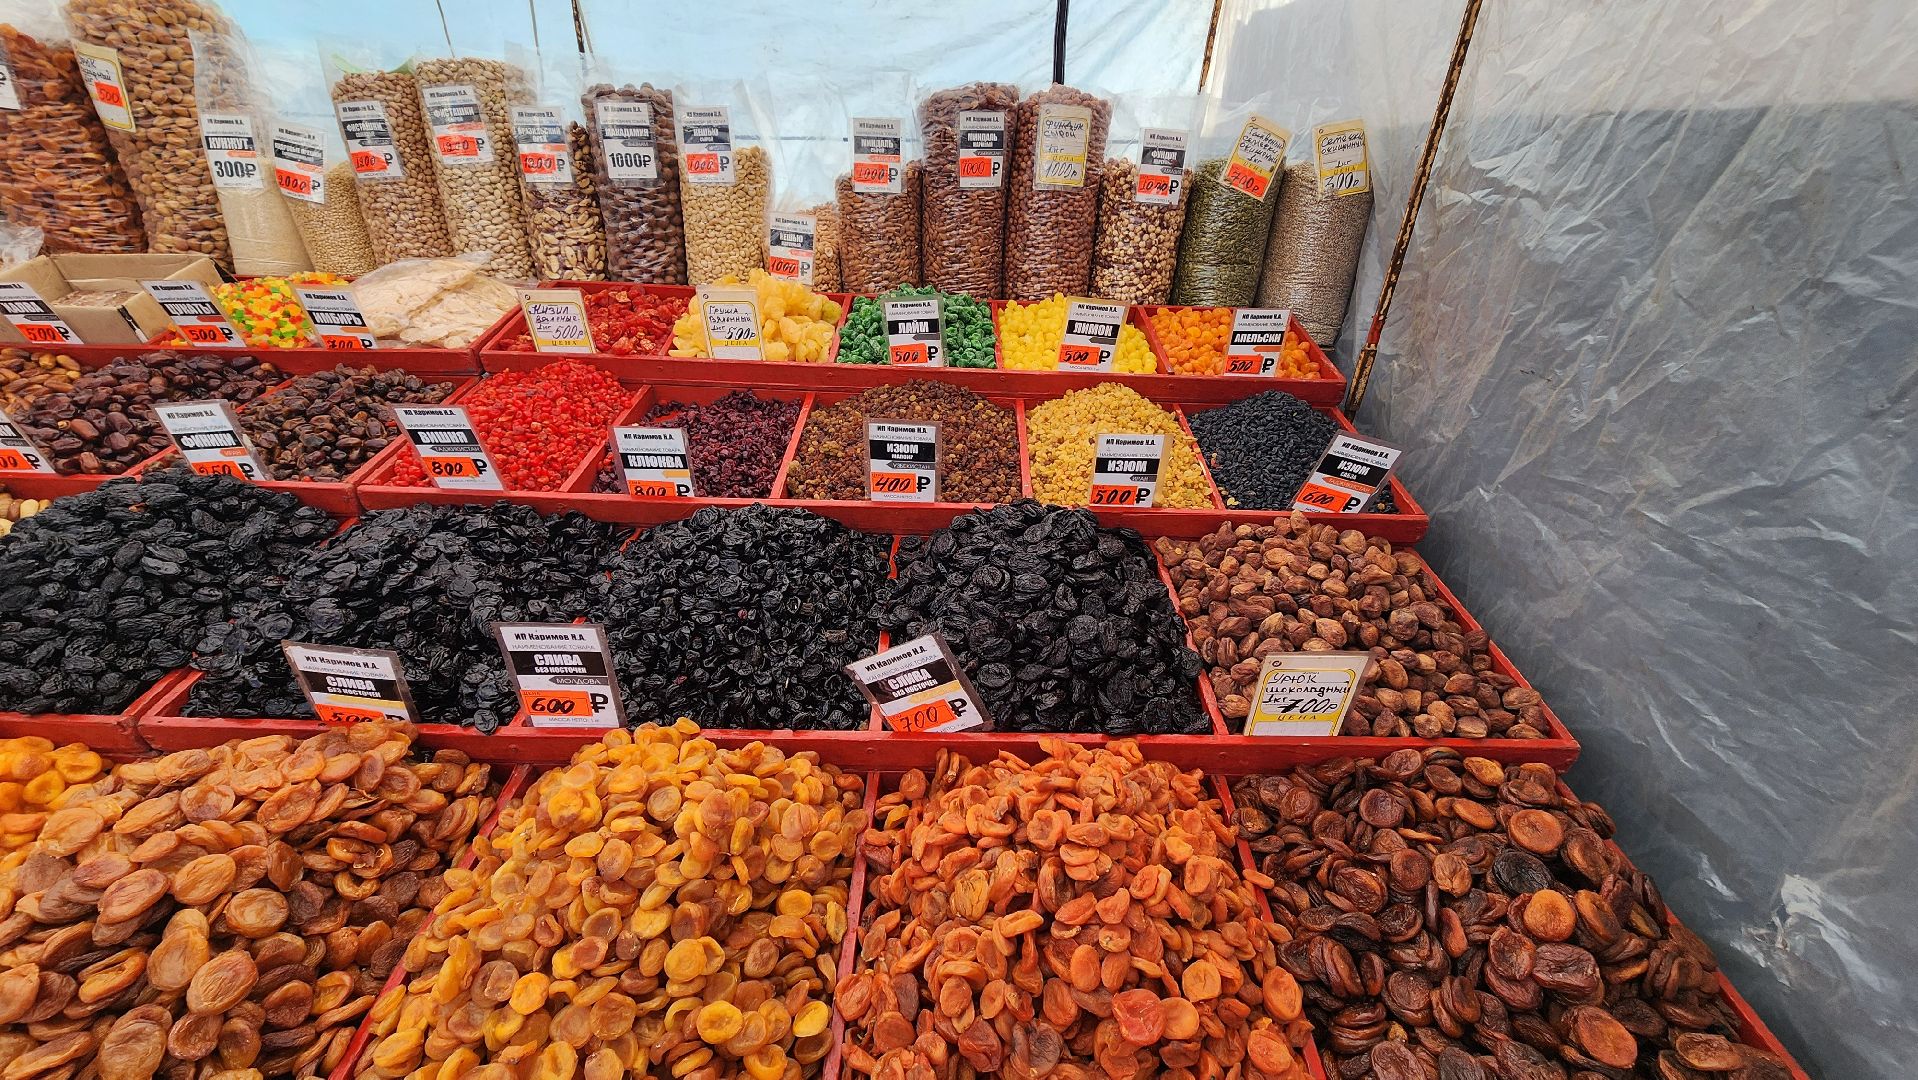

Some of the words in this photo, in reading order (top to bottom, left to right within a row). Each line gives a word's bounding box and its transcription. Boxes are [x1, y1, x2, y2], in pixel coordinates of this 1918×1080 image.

[432, 106, 475, 118] ФИСТАШКИ
[346, 121, 384, 132] ФИСТАШКИ
[605, 127, 649, 138] МАКАДАМИЯ
[693, 127, 719, 137] КЕШЬЮ
[208, 136, 249, 150] КУНЖУТ
[860, 139, 894, 149] МИНДАЛЬ
[966, 131, 999, 143] МИНДАЛЬ
[1151, 150, 1178, 161] ФУНДУК
[961, 160, 985, 174] 1000
[770, 256, 796, 273] 1000
[163, 302, 216, 316] ЦУКАТЫ
[311, 311, 364, 326] ИМБИРЬ
[27, 326, 56, 341] 500
[897, 319, 930, 334] ЛАЙМ
[1072, 321, 1115, 338] ЛИМОН
[189, 330, 217, 341] 500
[894, 351, 919, 363] 500
[1064, 349, 1089, 363] 500
[1228, 360, 1254, 373] 500
[412, 409, 444, 417] Каримов
[180, 433, 237, 448] ФИНИКИ
[416, 431, 469, 444] ВИШНЯ
[632, 433, 663, 441] Каримов
[1115, 438, 1144, 446] Каримов
[886, 442, 919, 455] ИЗЮМ
[1350, 442, 1379, 457] Каримов
[431, 461, 463, 476] 800
[627, 454, 685, 469] КЛЮКВА
[1106, 459, 1148, 473] ИЗЮМ
[1336, 459, 1371, 476] ИЗЮМ
[634, 486, 667, 497] 800
[875, 477, 912, 492] 400
[1093, 488, 1130, 505] 500
[1302, 491, 1335, 505] 600
[528, 633, 570, 642] Каримов
[304, 654, 318, 663] ИП
[318, 655, 362, 668] Каримов
[533, 653, 584, 666] СЛИВА
[864, 663, 878, 672] ИП
[878, 652, 913, 669] Каримов
[325, 675, 376, 692] СЛИВА
[887, 668, 933, 690] СЛИВА
[327, 685, 343, 694] БЕЗ
[892, 690, 906, 698] БЕЗ
[530, 697, 576, 715] 600
[1262, 693, 1288, 703] 1кг
[1277, 698, 1338, 714] 700р
[899, 706, 939, 732] 700
[1277, 714, 1318, 722] ЦЕНА
